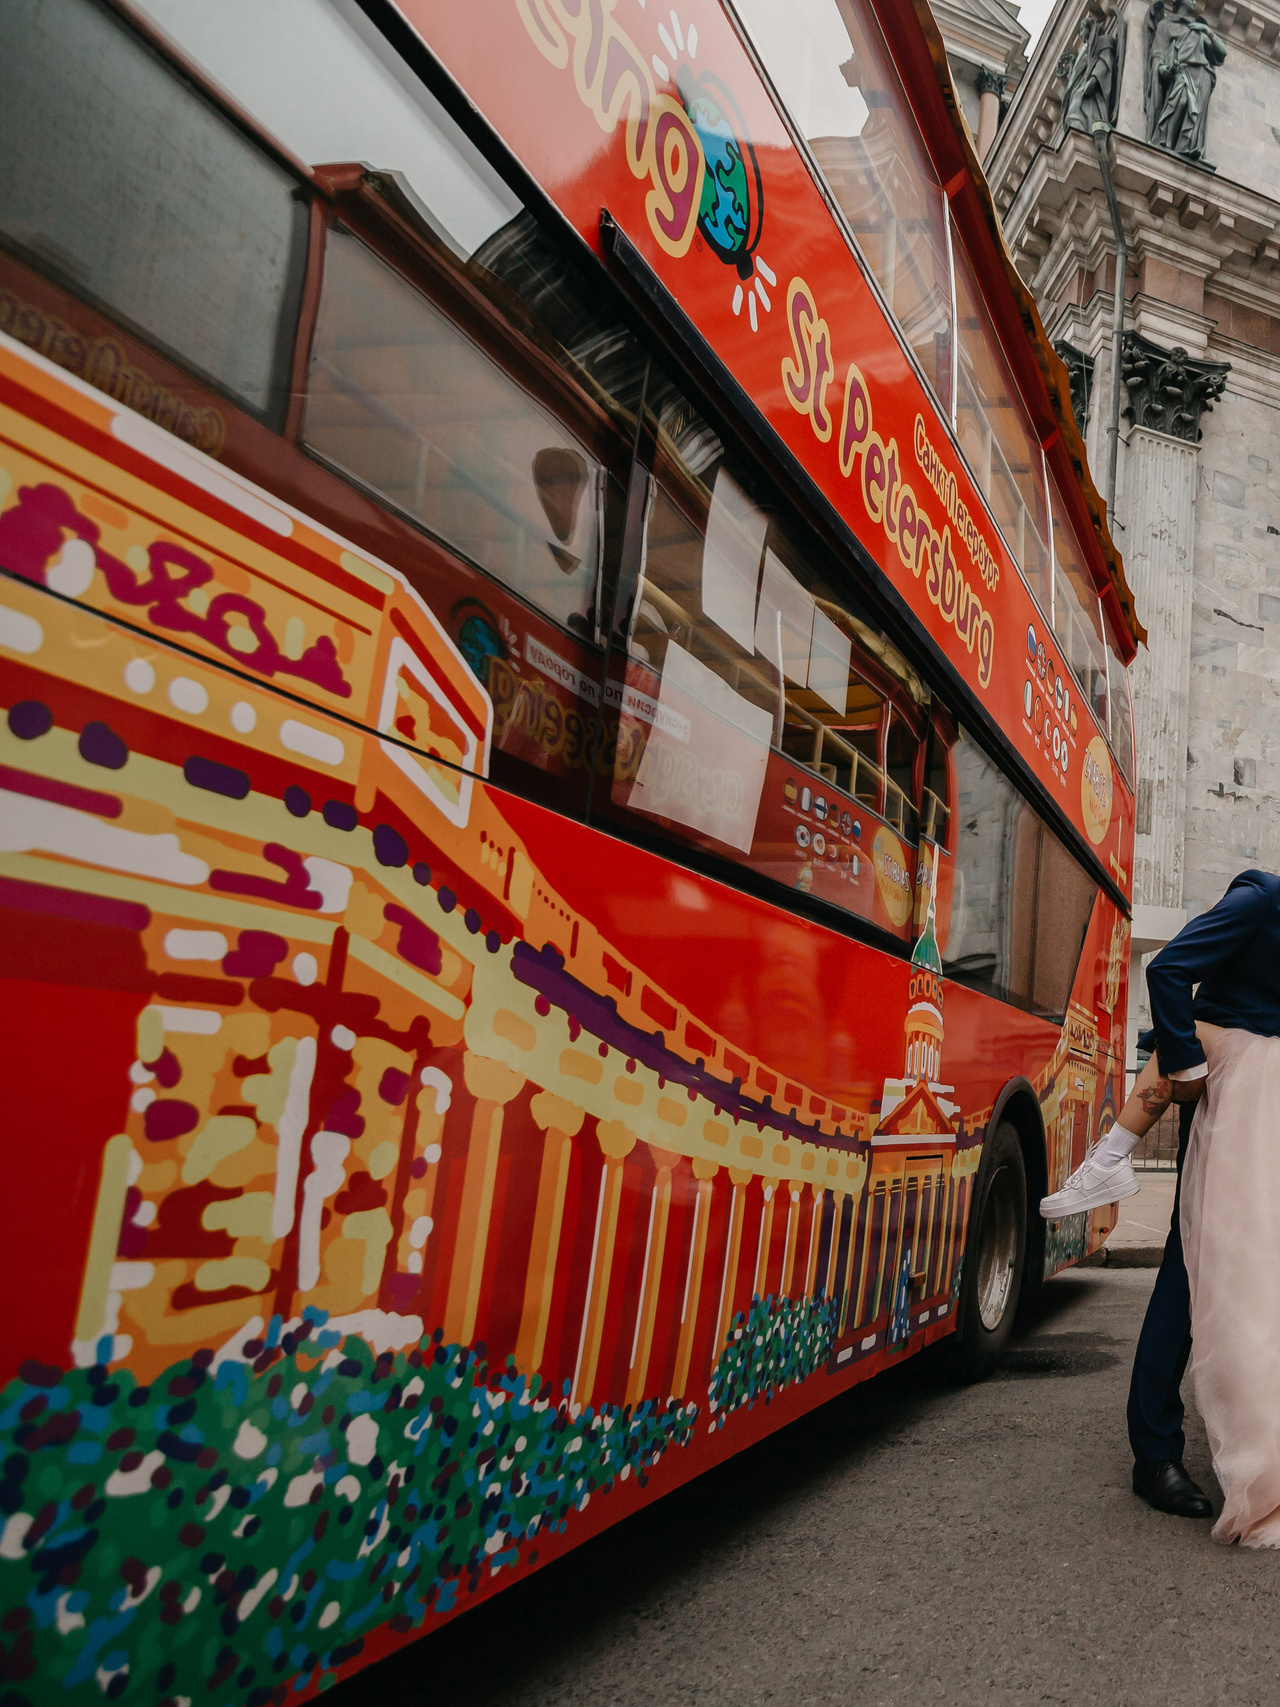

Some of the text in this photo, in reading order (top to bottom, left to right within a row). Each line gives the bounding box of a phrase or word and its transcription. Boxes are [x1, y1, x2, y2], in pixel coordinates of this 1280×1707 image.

[781, 276, 994, 690] St Petersburg
[914, 412, 1000, 592] Санкт-Петербург
